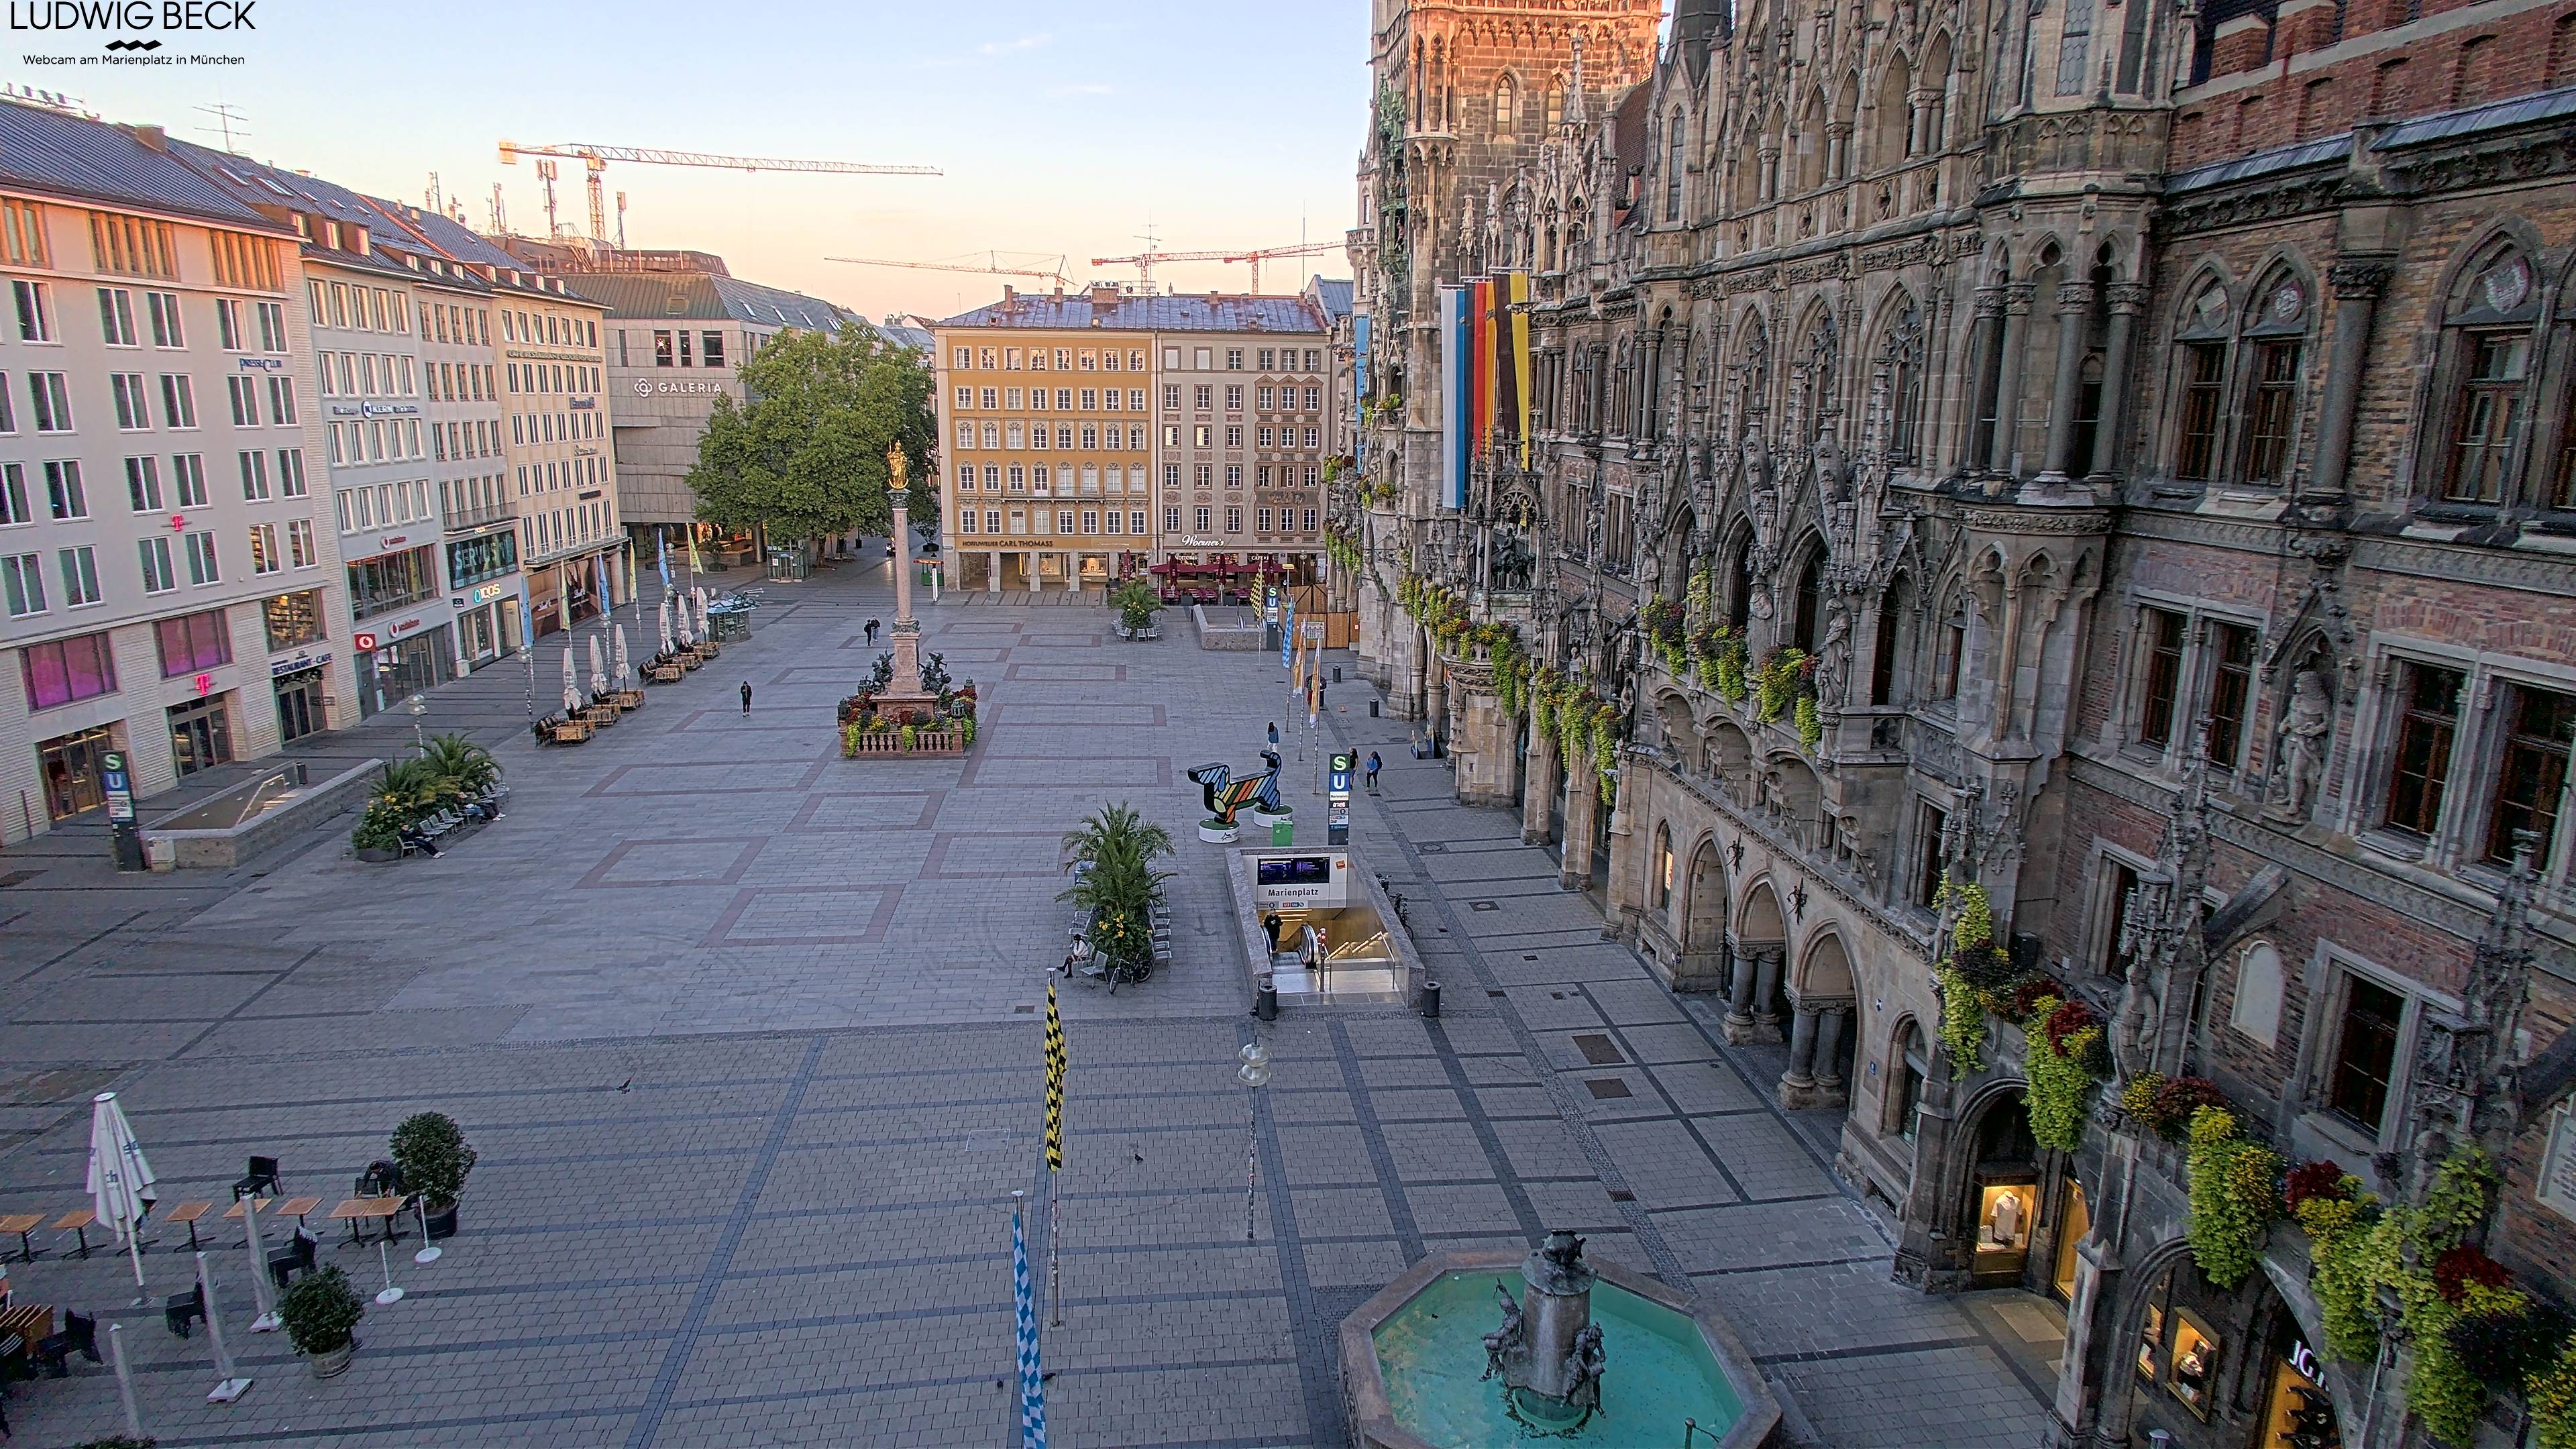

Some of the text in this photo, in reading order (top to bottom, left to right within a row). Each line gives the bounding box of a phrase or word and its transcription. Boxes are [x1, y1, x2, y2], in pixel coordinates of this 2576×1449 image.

[658, 382, 722, 393] GALERIA
[1269, 588, 1277, 596] S
[1269, 598, 1276, 606] U
[195, 674, 211, 696] T
[105, 754, 121, 770] S
[1334, 755, 1347, 771] S
[107, 773, 122, 788] U
[1334, 775, 1345, 790] U
[1268, 888, 1319, 898] Marienplatz
